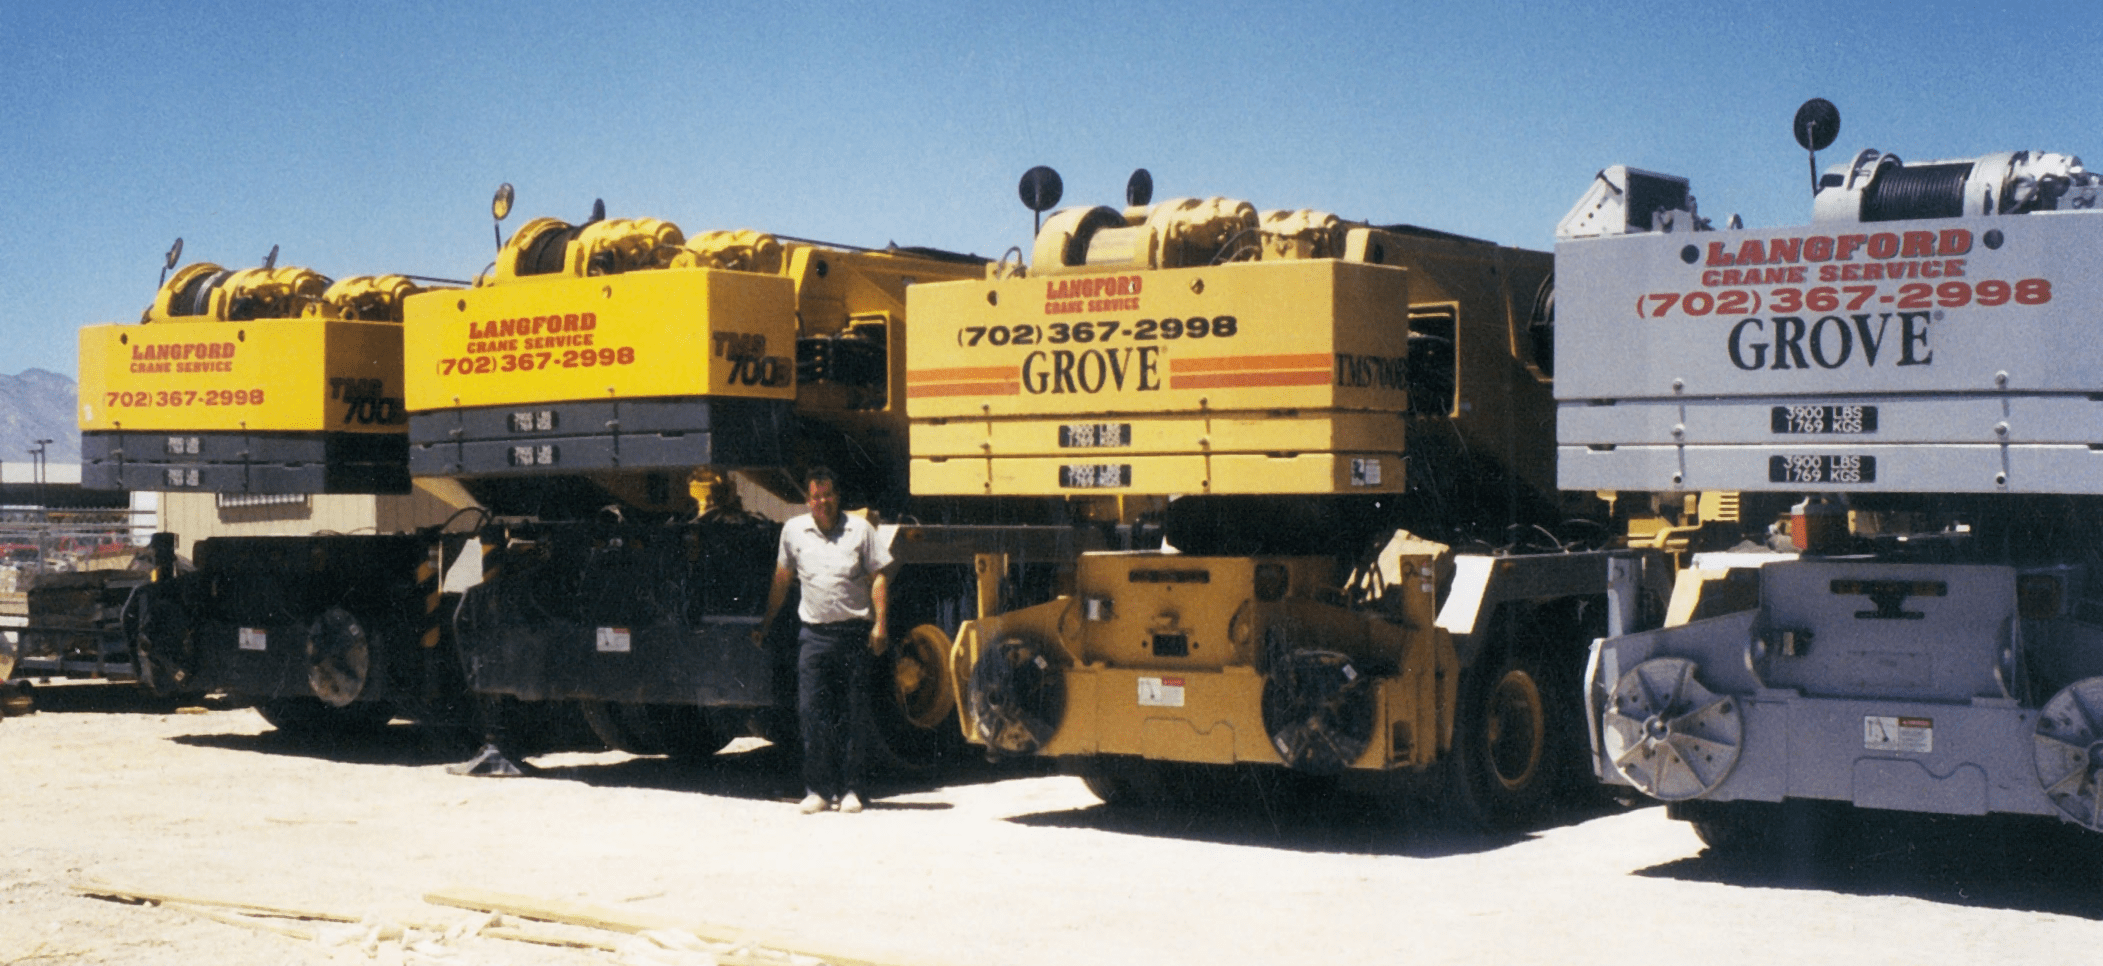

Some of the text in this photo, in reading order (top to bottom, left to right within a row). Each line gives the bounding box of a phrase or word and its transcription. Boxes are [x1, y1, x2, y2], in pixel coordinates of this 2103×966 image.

[1705, 228, 1973, 267] LANGFORD
[1701, 258, 1967, 288] CRANE SERVICE
[1045, 275, 1143, 300] LANGFORD
[1636, 278, 2053, 319] (702) 367-2998
[1045, 297, 1140, 315] CRANE SERVICE
[469, 312, 597, 340] LANGFORD
[957, 315, 1239, 347] (702) 367-2998
[132, 342, 236, 361] LANGFORD
[466, 333, 594, 354] CRANE SERVICE
[1728, 311, 1934, 371] GROVE
[130, 361, 233, 374] CRANE SERVICE
[436, 346, 636, 376] (702) 367-2998
[1022, 346, 1161, 395] GROVE
[157, 389, 265, 406] 367-2998
[1785, 405, 1862, 420] 3900 LBS
[1786, 419, 1862, 433] 1769 KGS
[1783, 454, 1861, 469] 3900 LBS
[1784, 467, 1861, 482] 1769 KGS
